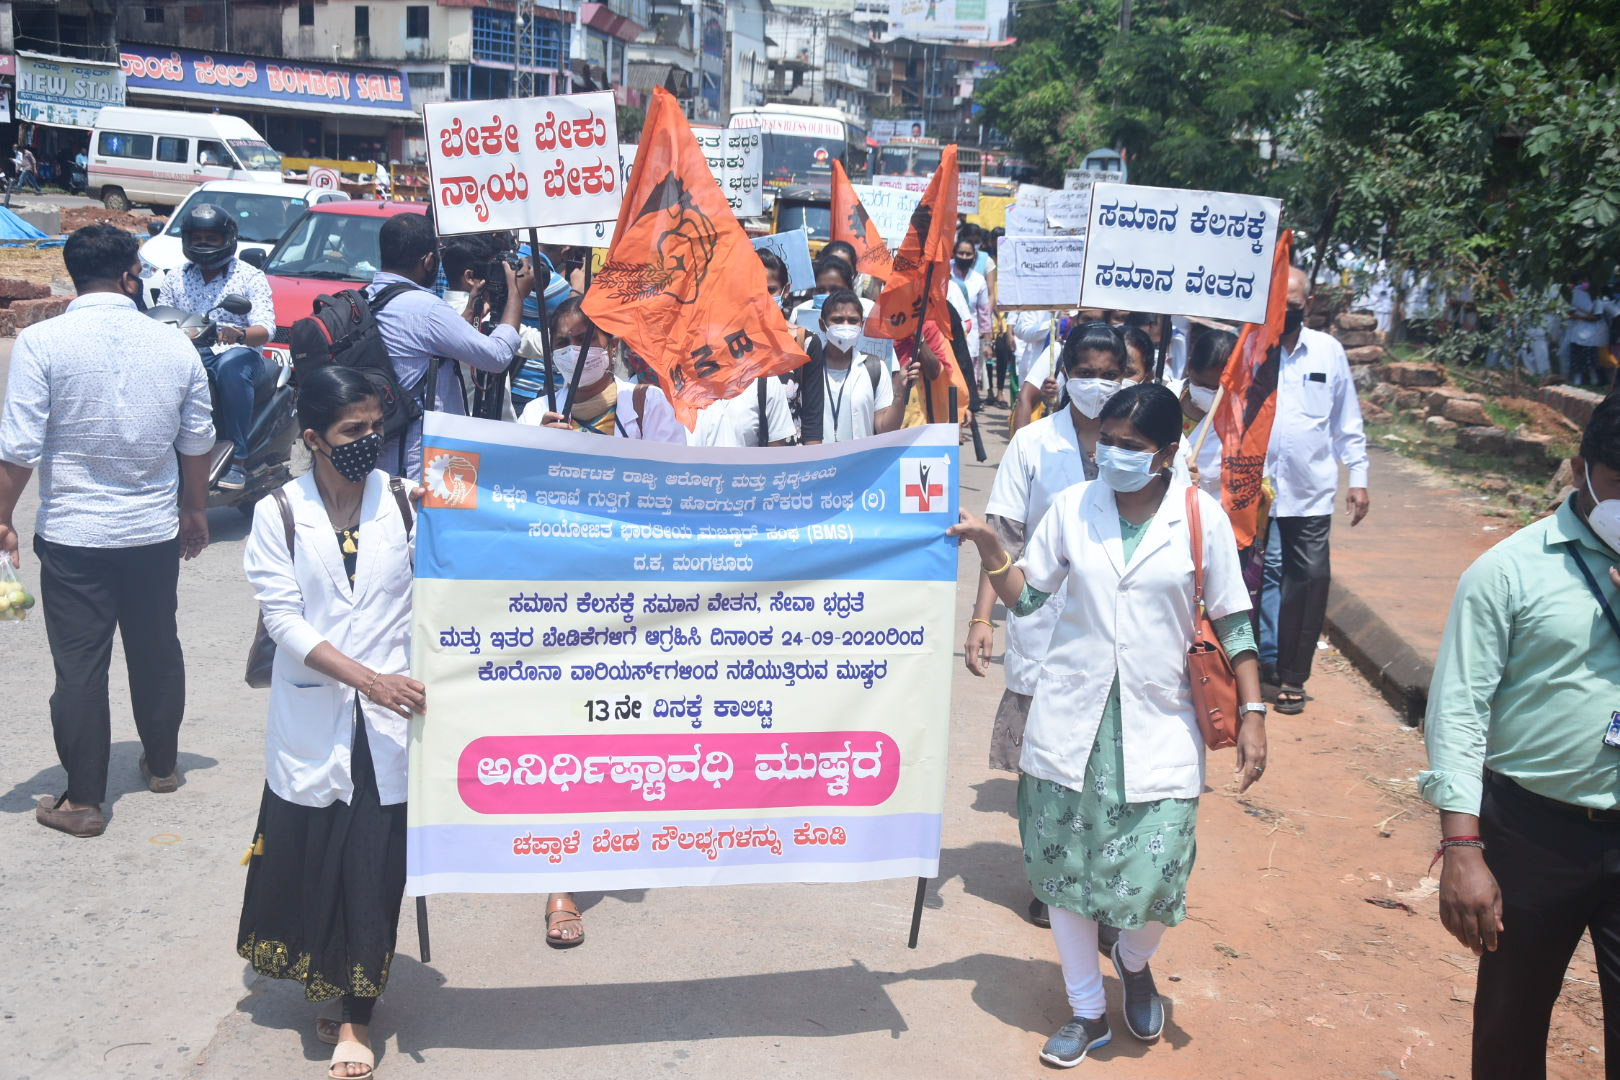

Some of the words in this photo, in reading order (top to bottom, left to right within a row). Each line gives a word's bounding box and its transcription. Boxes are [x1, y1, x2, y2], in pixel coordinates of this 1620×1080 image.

[20, 72, 67, 96] NEW
[74, 79, 125, 100] STAR
[194, 56, 258, 88] ಸೇಲ್
[266, 64, 351, 101] BOMBAY
[355, 72, 404, 102] SALE
[440, 115, 520, 158] ಬೇಕೇ
[535, 108, 607, 151] ಬೇಕು
[784, 119, 807, 132] BLESS
[808, 121, 823, 134] OUR
[439, 161, 529, 223] ನ್ಯಾಯ
[543, 156, 615, 198] ಬೇಕು
[1099, 199, 1178, 232] ಸಮಾನ
[1190, 205, 1266, 254] ಕೆಲಸಕ್ಕೆ
[1095, 258, 1175, 292] ಸಮಾನ
[1185, 265, 1255, 300] ವೇತನ
[547, 463, 616, 482] ಕರ್ನಾಟಕ
[622, 468, 658, 490] ರಾಜ್ಯ
[665, 471, 725, 494] ಆರೋಗ್ಯ
[731, 473, 767, 492] ಮತ್ತು
[772, 466, 837, 490] ವೈದ್ಯಕೀಯ
[492, 484, 528, 511] ಶಿಕ್ಷಣ
[535, 488, 581, 506] ಇಲಾಖೆ
[587, 491, 630, 513] ಗುತ್ತಿಗೆ
[637, 494, 673, 516] ಮತ್ತು
[680, 496, 756, 517] ಹೊರಗುತ್ತಿಗೆ
[762, 491, 813, 511] ನೌಕರರ
[820, 491, 854, 511] ಸಂಘ
[861, 488, 887, 512] (ರಿ)
[621, 522, 693, 541] ಭಾರತೀಯ
[766, 525, 800, 542] ಸಂಘ
[807, 523, 855, 544] (BMS)
[672, 552, 753, 572] ಮಂಗಳೂರು
[508, 592, 568, 613] ಸಮಾನ
[576, 592, 635, 623] ಕೆಲಸಕ್ಕೆ
[643, 593, 700, 613] ಸಮಾನ
[707, 592, 761, 614] ವೇತನ,
[770, 591, 815, 612] ಸೇವಾ
[823, 591, 865, 619] ಭದ್ರತೆ
[440, 626, 481, 654] ಮತ್ತು
[490, 627, 534, 650] ಇತರ
[542, 626, 637, 647] ಬೇಡಿಕೆಗಳಿಗೆ
[645, 625, 701, 652] ಆಗ್ರಹಿಸಿ
[710, 626, 773, 646] ದಿನಾಂಕ
[478, 660, 562, 681] ಕೊರೊನಾ
[726, 659, 828, 686] ನಡೆಯುತ್ತಿರುವ
[836, 659, 887, 689] ಮುಷ್ಕರ
[653, 694, 703, 729] ದಿನಕ್ಕೆ
[713, 699, 773, 729] ಕಾಲಿಟ್ಟ
[477, 743, 735, 802] ಅನಿರ್ಧಿಷ್ಟಾವಧಿ
[754, 740, 884, 797] ಮುಷ್ಕರ
[513, 829, 581, 864] ಚಪ್ಪಾಳೆ
[592, 828, 641, 853] ಬೇಡ
[651, 825, 784, 861] ಸೌಲಭ್ಯಗಳನ್ನು
[793, 822, 848, 846] ಕೊಡಿ
